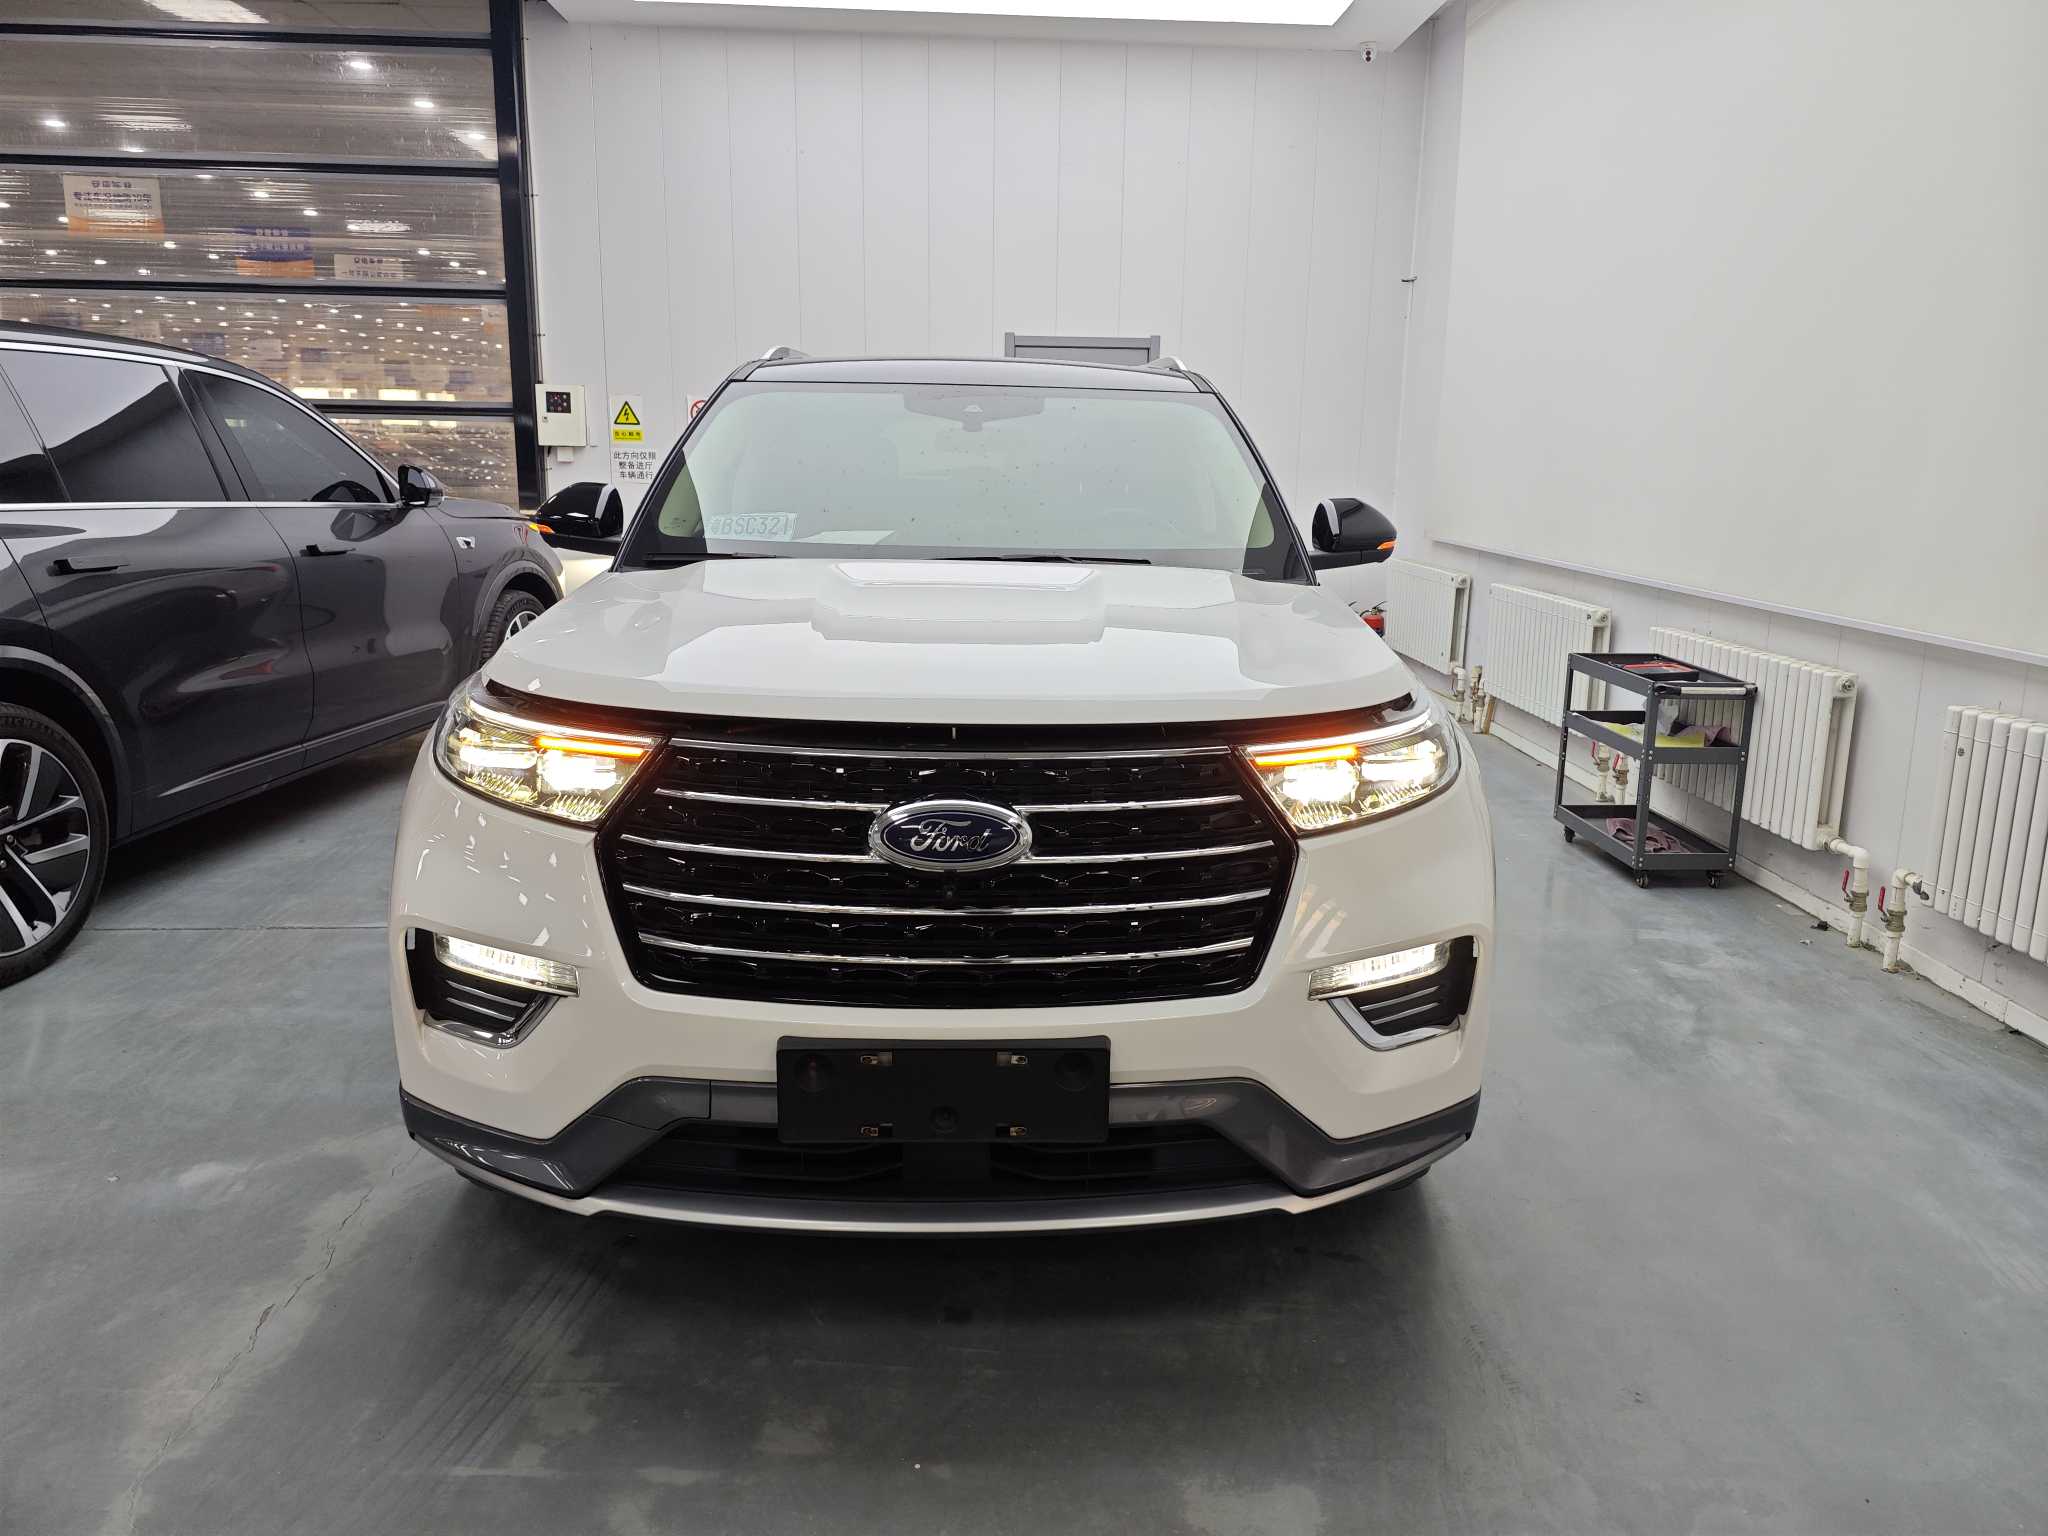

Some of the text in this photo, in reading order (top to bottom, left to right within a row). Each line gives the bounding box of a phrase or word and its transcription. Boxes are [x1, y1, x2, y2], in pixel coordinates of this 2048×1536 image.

[613, 451, 656, 460] 此方向仅限
[619, 471, 654, 480] 车辆通行
[900, 818, 992, 852] Ford
